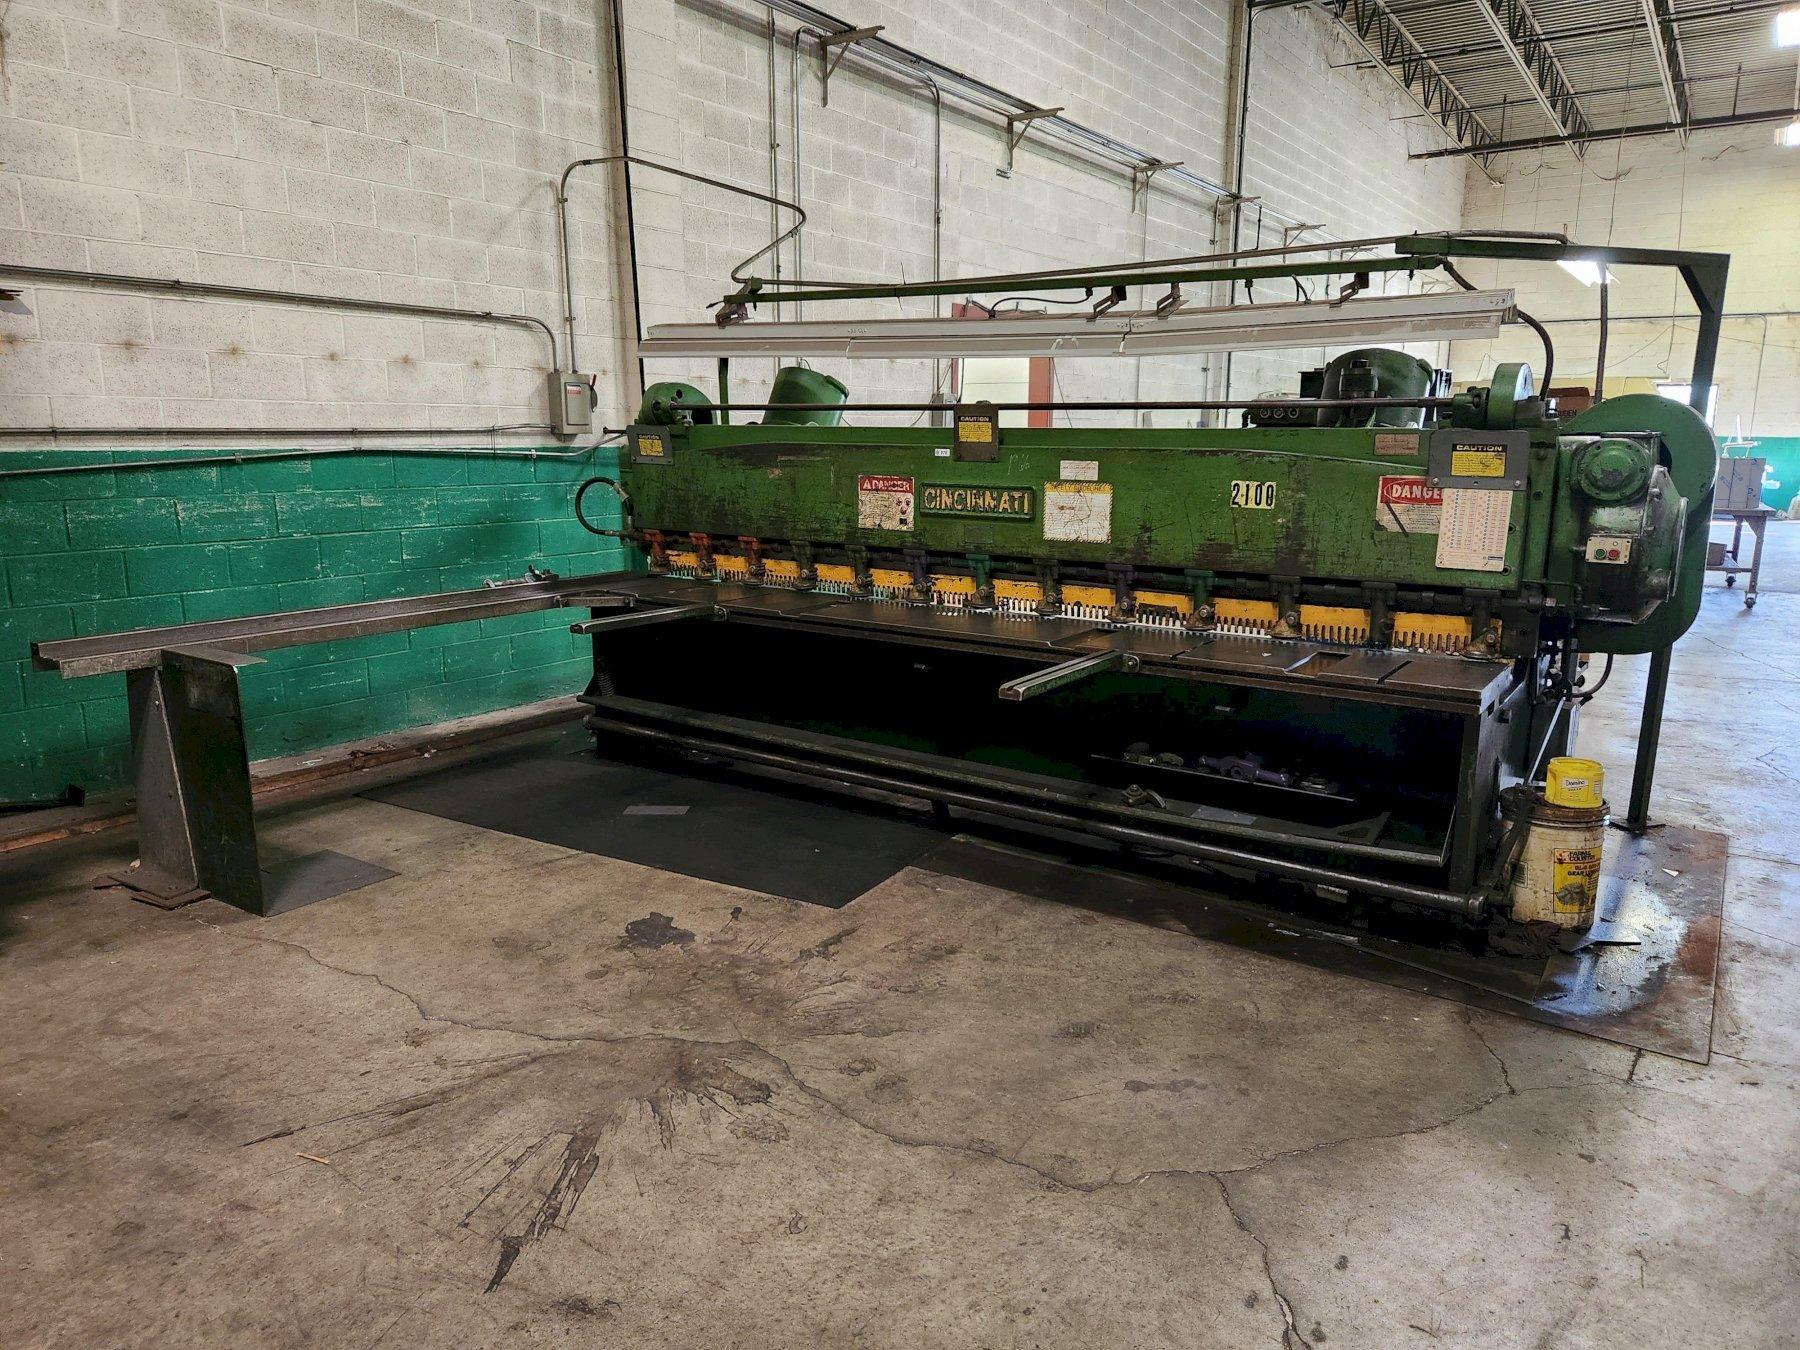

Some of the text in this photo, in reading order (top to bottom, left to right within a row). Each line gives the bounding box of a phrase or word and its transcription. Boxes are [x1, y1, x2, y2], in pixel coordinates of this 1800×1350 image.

[872, 480, 910, 491] DANGER
[1231, 482, 1274, 507] 2100
[1391, 484, 1443, 499] DANGE
[924, 487, 1029, 515] CINCINNATI
